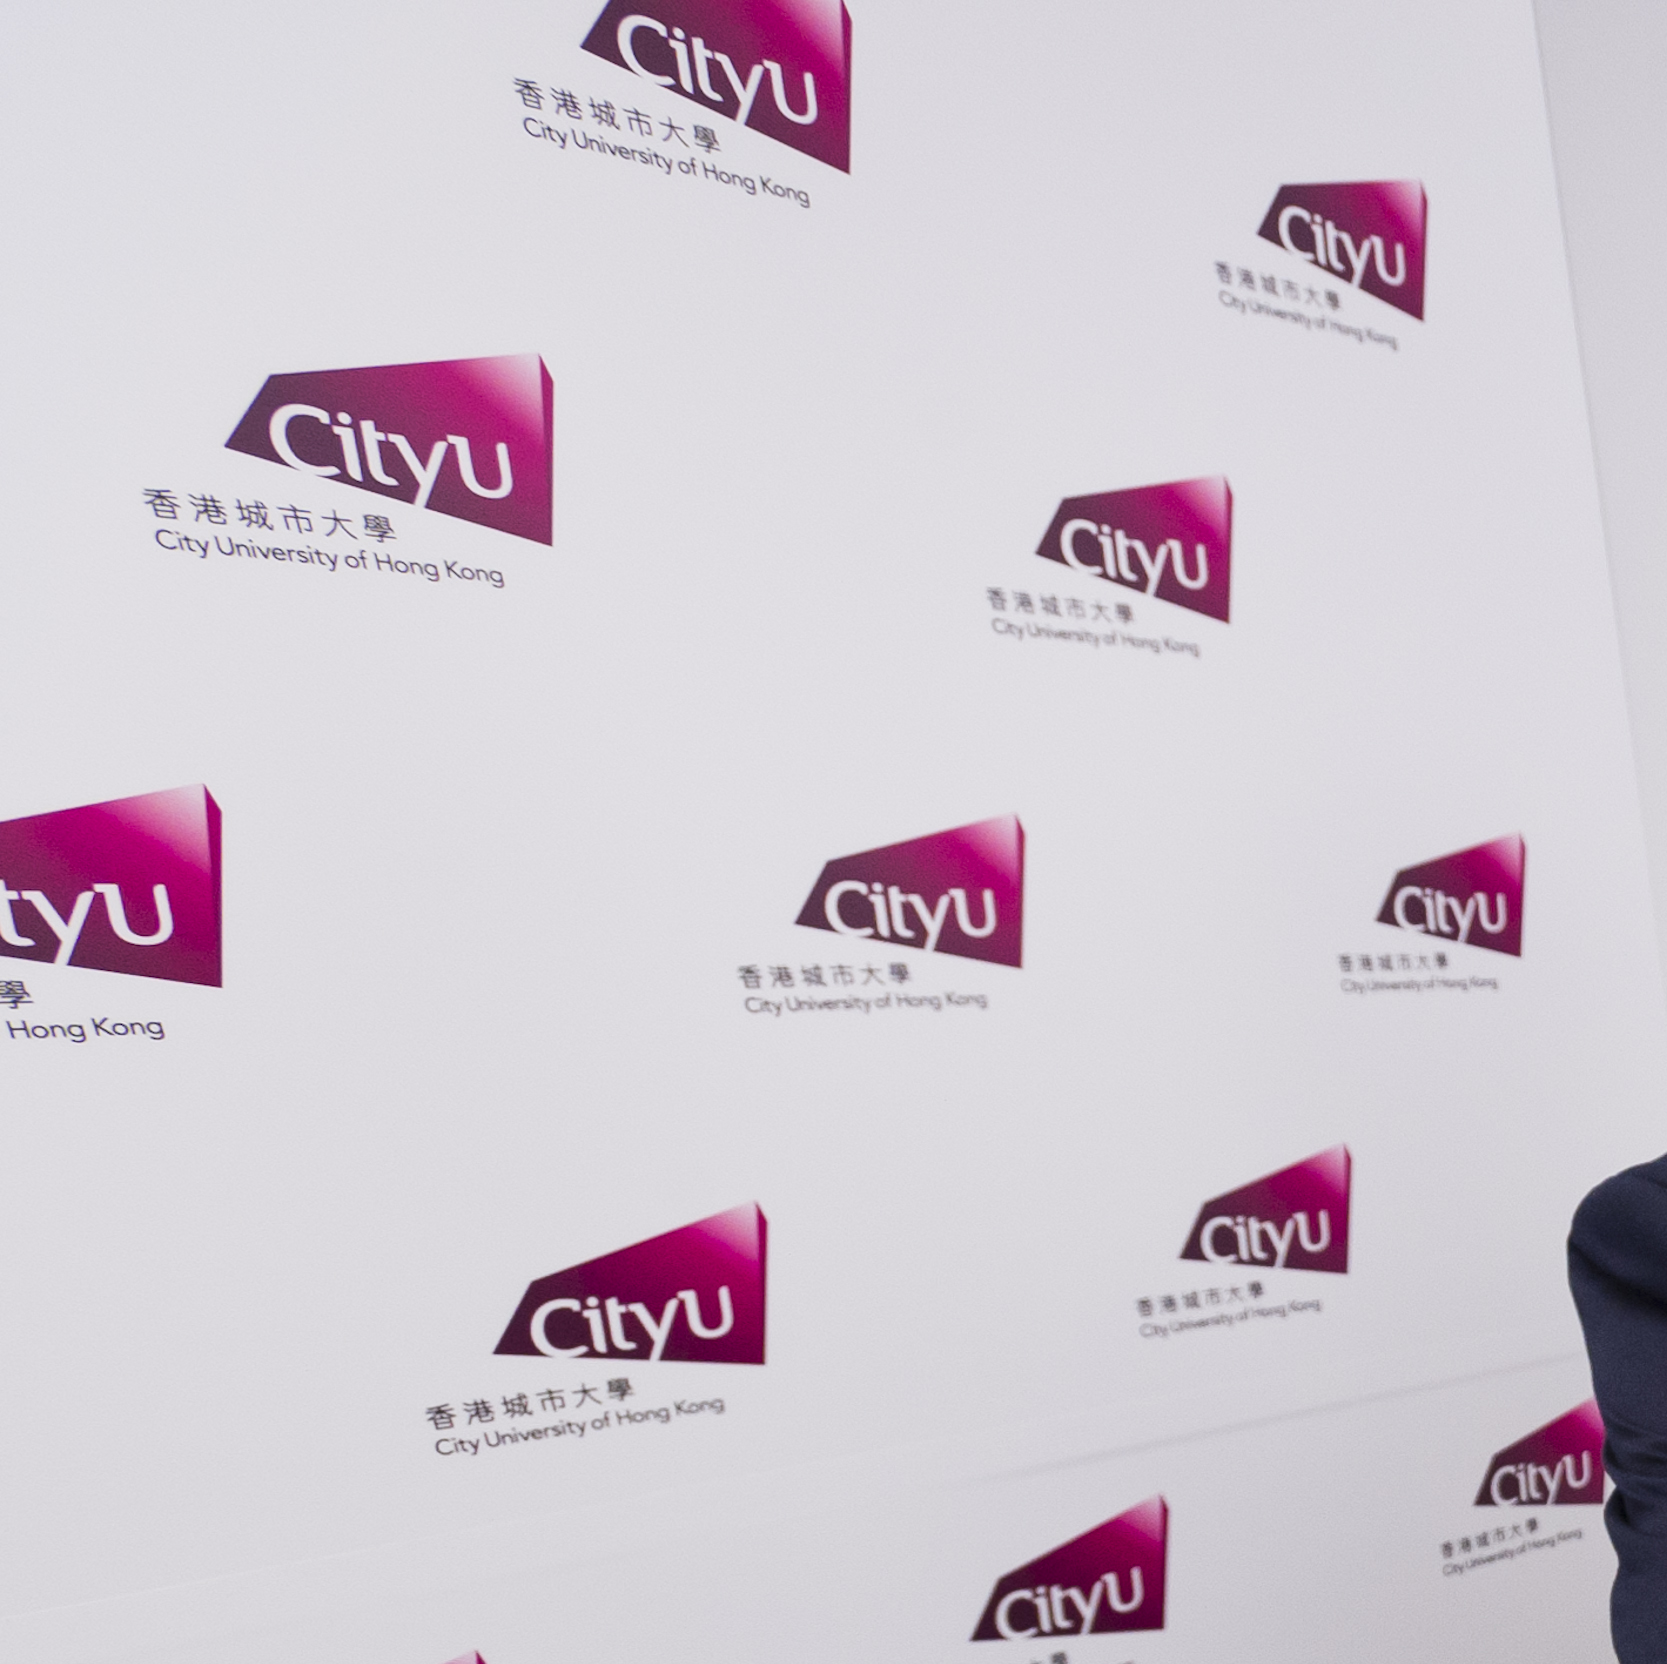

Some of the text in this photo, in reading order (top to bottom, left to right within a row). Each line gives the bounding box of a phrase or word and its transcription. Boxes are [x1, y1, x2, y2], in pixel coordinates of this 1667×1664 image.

[616, 14, 819, 127] CityU
[513, 77, 722, 154] 香港城市大學
[522, 116, 811, 209] City University of Hong Kong
[1278, 205, 1405, 289] CityU
[268, 402, 514, 509] CityU
[143, 488, 397, 544] 香港城市大學
[154, 528, 505, 589] City University of Hong Kong
[1060, 518, 1208, 598] CityU
[986, 587, 1135, 626] 香港城市大學
[0, 879, 174, 965] tyU
[824, 880, 997, 953] CityU
[1394, 885, 1507, 944] CityU
[737, 961, 914, 990] 香港城市大學
[5, 1017, 166, 1044] Hong Kong
[1201, 1207, 1330, 1269] CityU
[530, 1284, 735, 1362] CityU
[426, 1376, 636, 1431] 香港城市大學
[434, 1397, 728, 1457] City University of Hong Kong
[1491, 1449, 1589, 1507] CityU
[995, 1563, 1144, 1641] CityU
